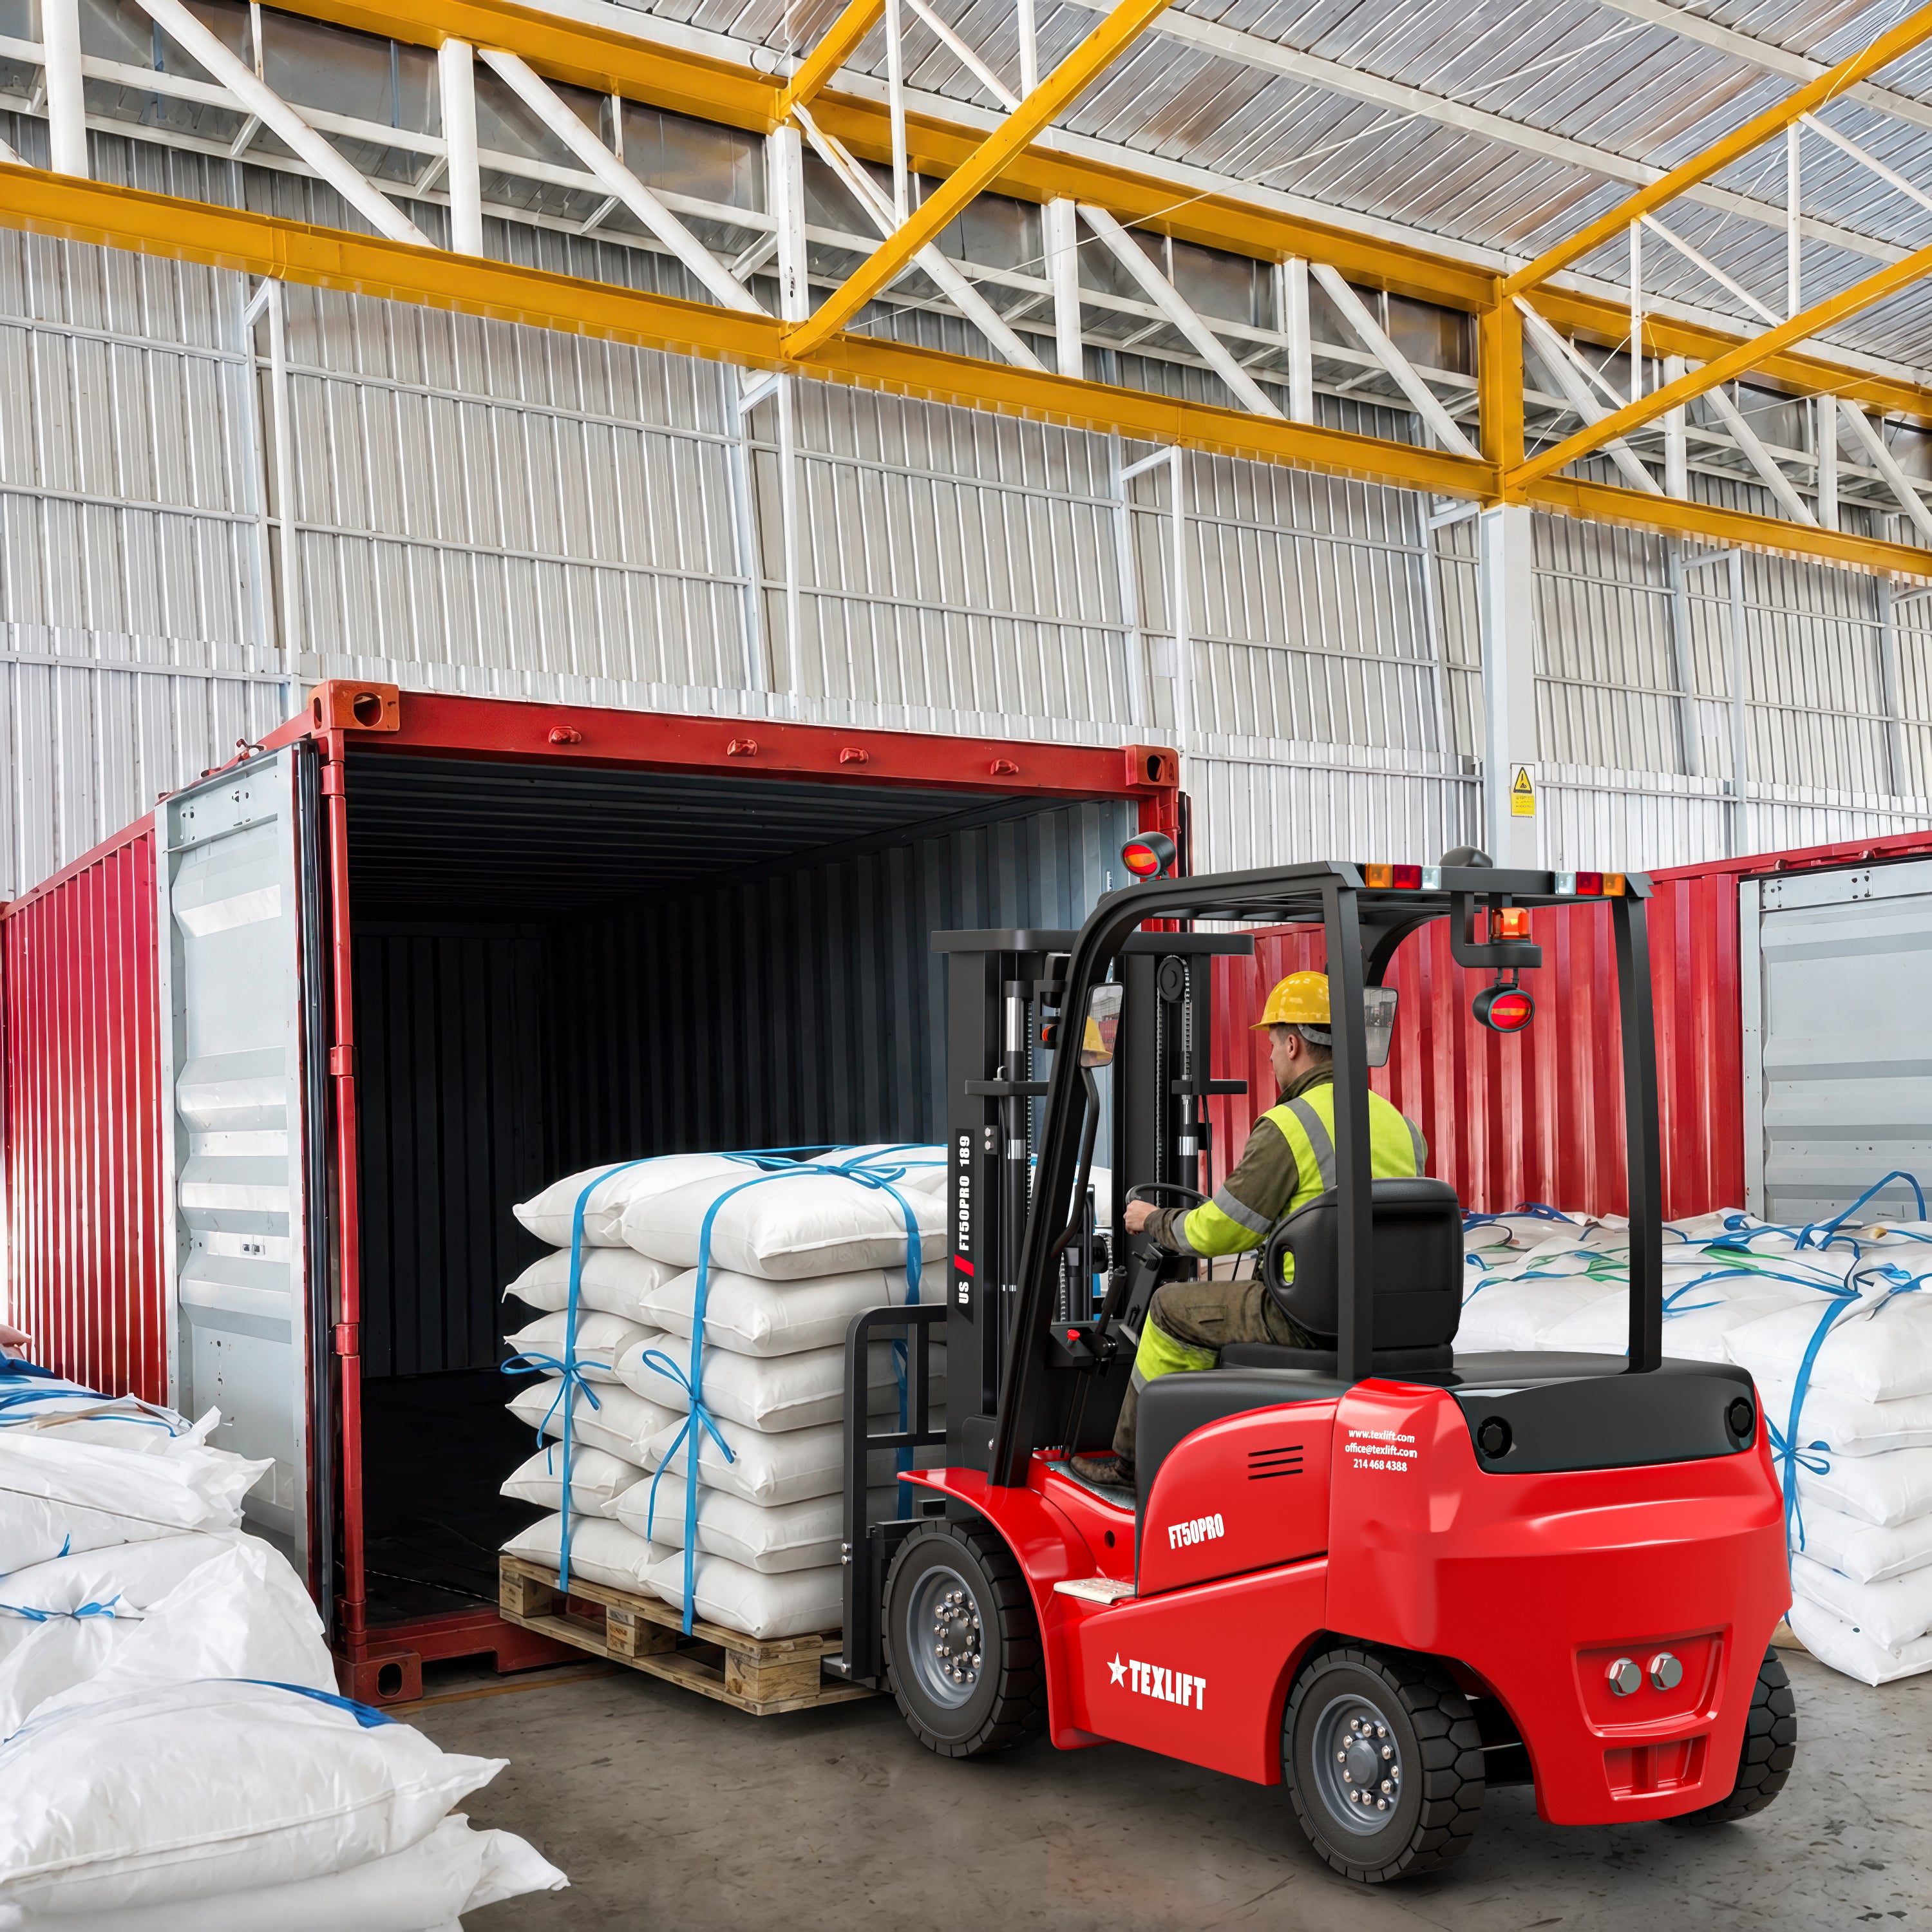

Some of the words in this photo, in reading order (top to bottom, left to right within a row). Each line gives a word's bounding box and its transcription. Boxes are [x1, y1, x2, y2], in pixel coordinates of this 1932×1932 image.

[959, 1135, 970, 1167] 189
[959, 1175, 970, 1251] FT50PRO
[958, 1282, 969, 1304] US
[1349, 1430, 1415, 1443] www.texlift.com
[1345, 1443, 1417, 1458] office@texlift.com
[1353, 1459, 1368, 1469] 214
[1369, 1459, 1385, 1470] 468
[1386, 1461, 1407, 1472] 4388
[1168, 1513, 1225, 1549] FT50PRO
[1129, 1659, 1206, 1710] TEXLIFT
